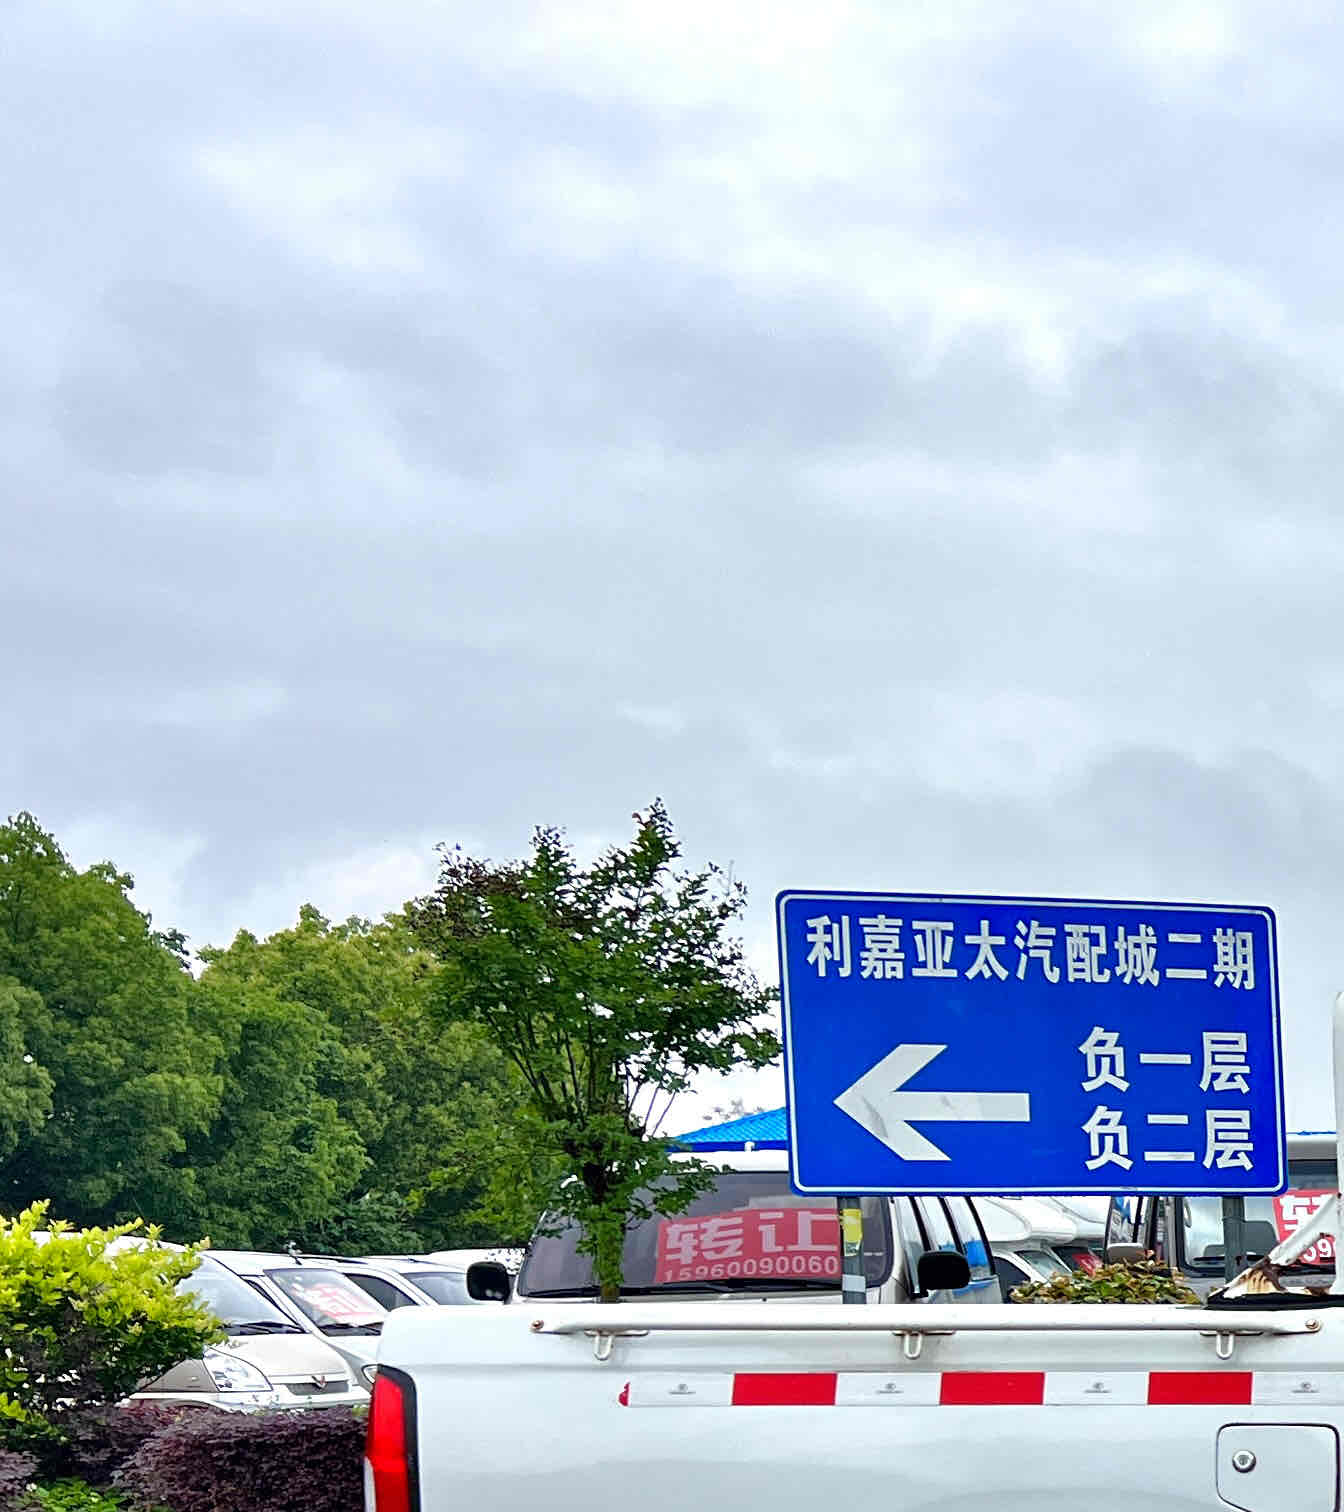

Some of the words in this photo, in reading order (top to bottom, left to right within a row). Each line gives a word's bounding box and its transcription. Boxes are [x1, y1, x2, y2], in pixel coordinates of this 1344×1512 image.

[806, 914, 1256, 990] 利嘉亚太汽配城二期
[1079, 1026, 1251, 1094] 负一层
[1082, 1105, 1255, 1172] 负二层
[664, 1256, 839, 1282] 15960090060
[665, 1211, 839, 1265] 转让
